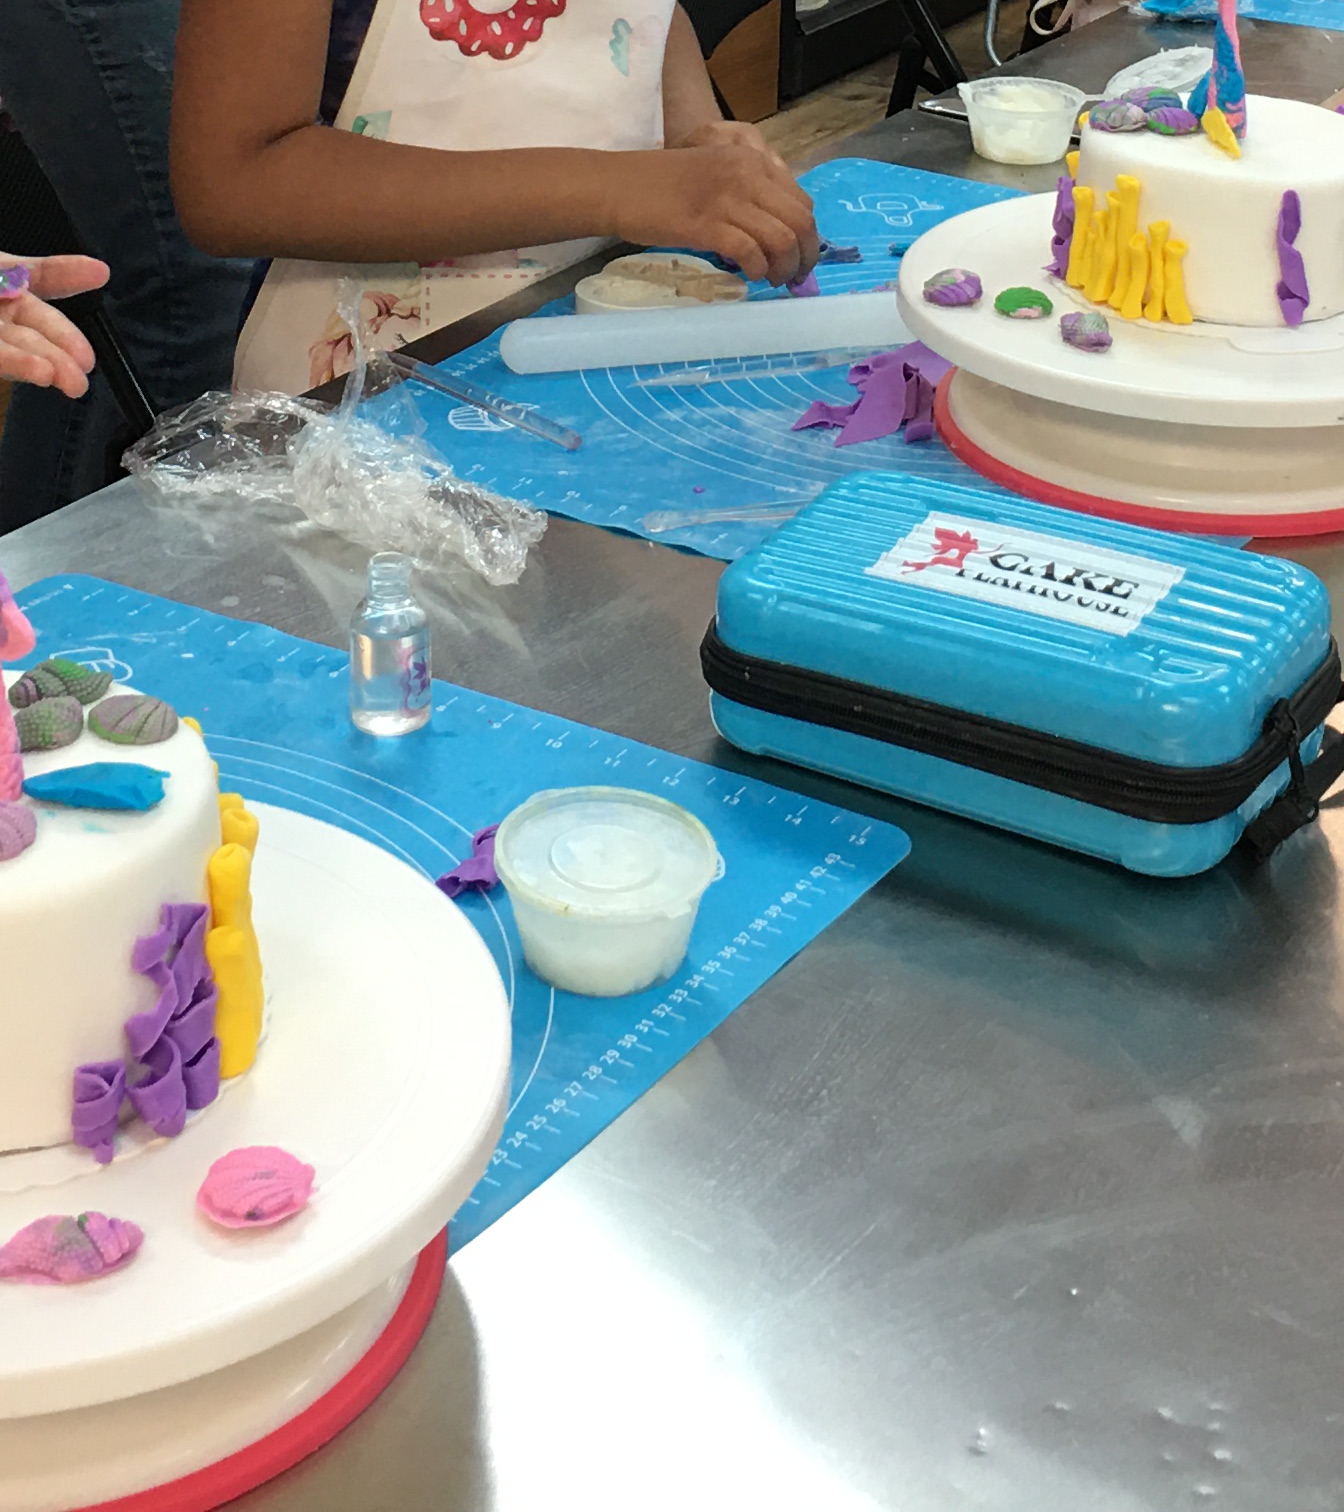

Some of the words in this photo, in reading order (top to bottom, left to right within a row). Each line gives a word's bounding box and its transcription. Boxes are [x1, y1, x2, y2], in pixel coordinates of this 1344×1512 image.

[988, 552, 1140, 600] CAKE
[545, 738, 563, 748] 10
[784, 814, 803, 825] 14
[506, 1131, 528, 1148] 24
[525, 1114, 547, 1130] 25
[544, 1098, 566, 1114] 26
[563, 1081, 583, 1097] 27
[581, 1065, 603, 1080] 28
[599, 1049, 620, 1065] 29
[617, 1033, 638, 1049] 30
[634, 1019, 654, 1033] 31
[651, 1003, 672, 1018] 32
[668, 988, 688, 1003] 33
[684, 974, 705, 988] 34
[701, 959, 721, 974] 35
[717, 945, 737, 959] 36
[733, 931, 750, 945] 37
[748, 918, 768, 932] 38
[764, 904, 782, 918] 39
